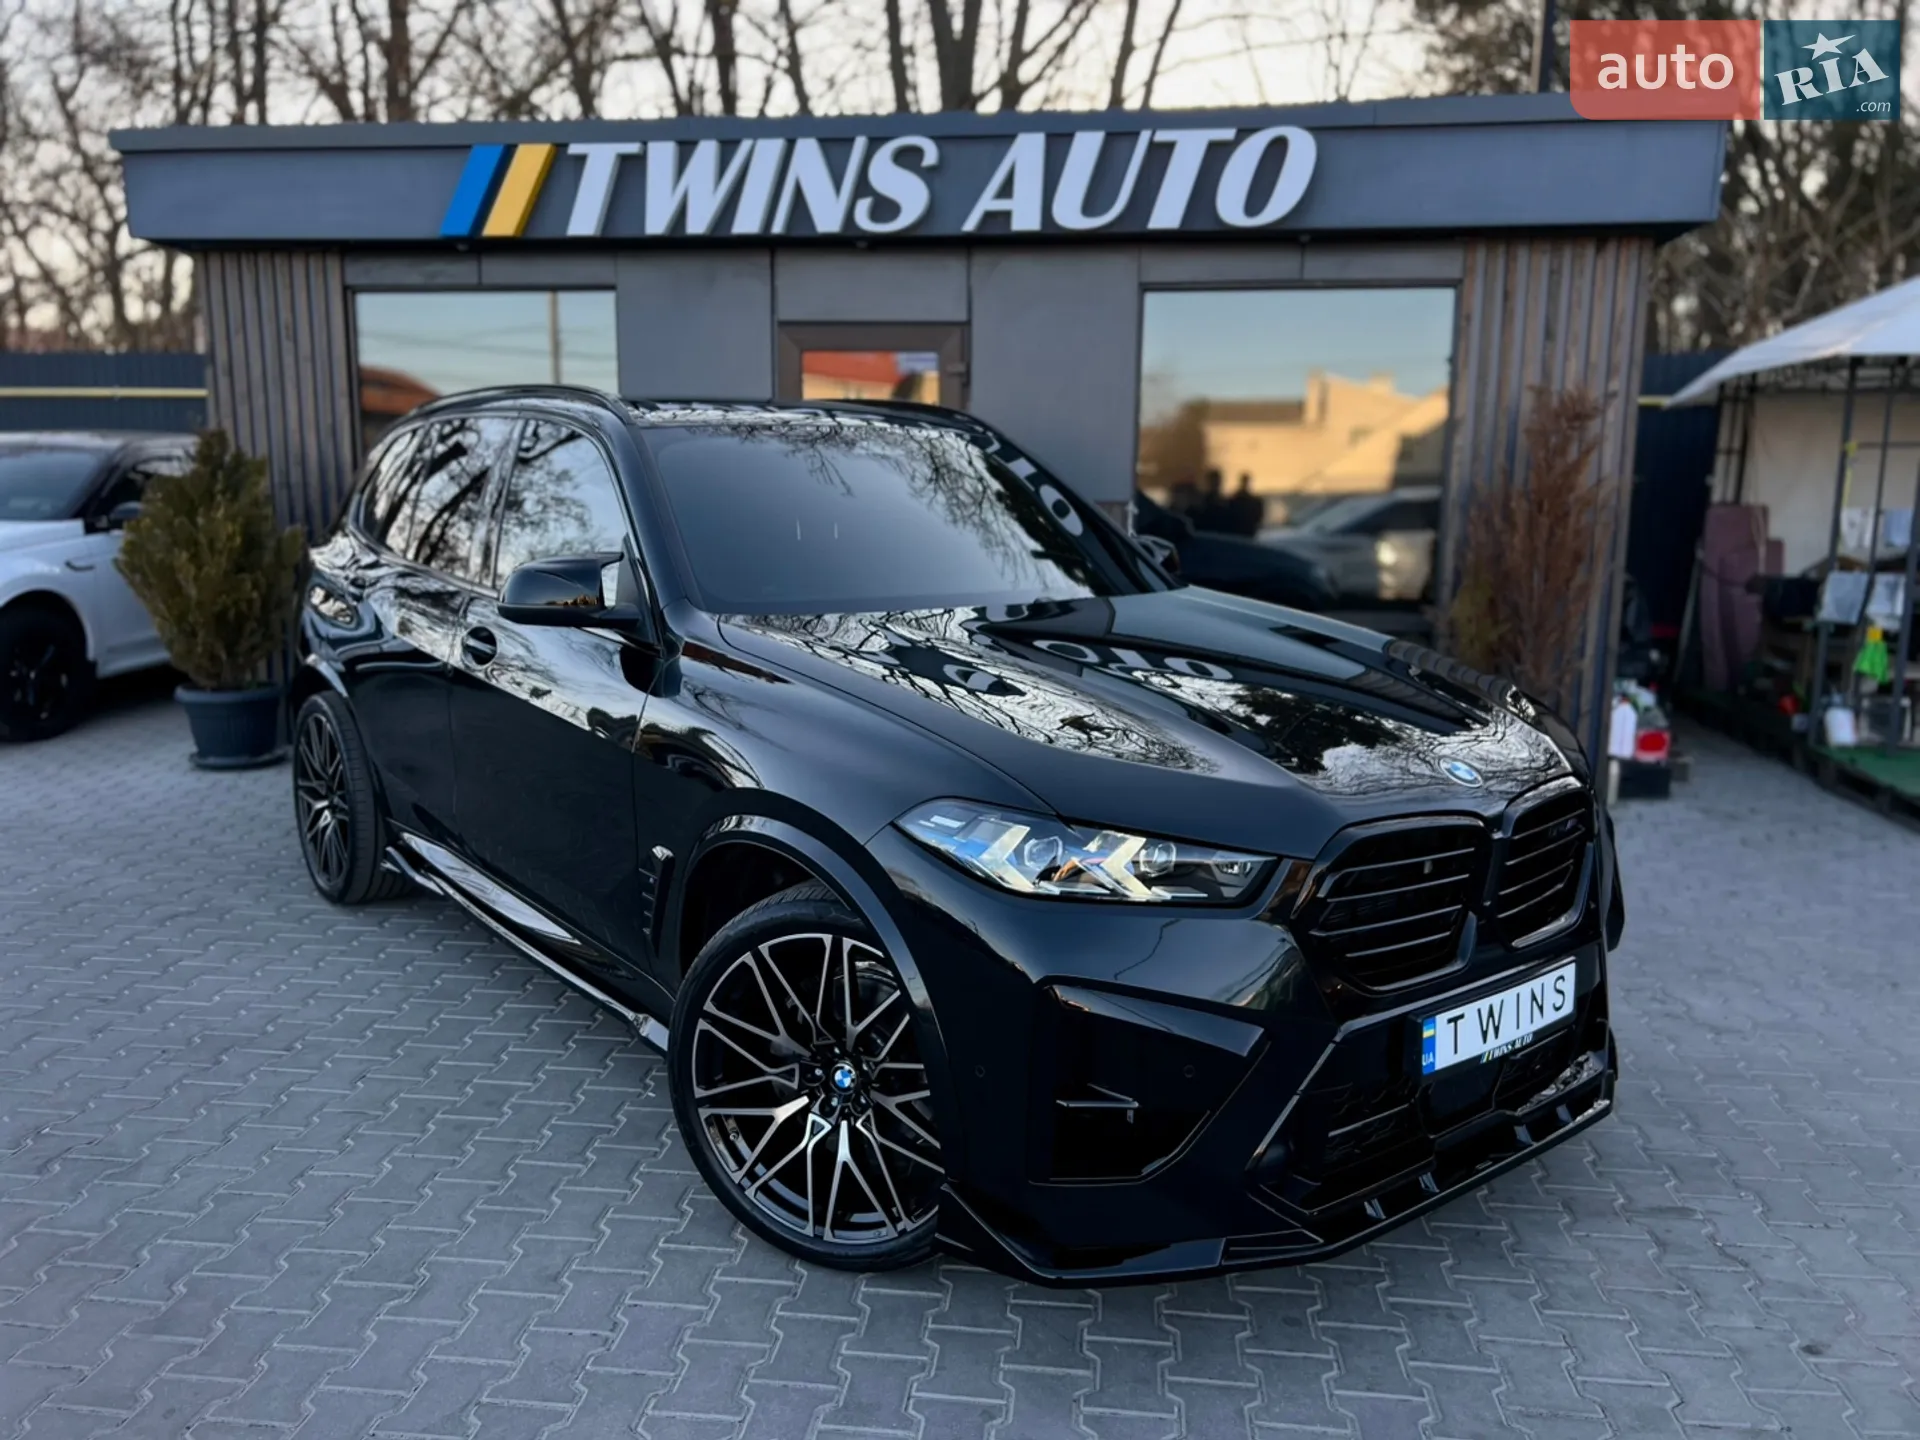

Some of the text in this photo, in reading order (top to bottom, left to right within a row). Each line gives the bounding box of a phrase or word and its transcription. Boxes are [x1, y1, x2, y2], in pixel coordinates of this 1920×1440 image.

[565, 125, 1318, 237] TWINS AUTO
[1422, 1051, 1435, 1067] UA
